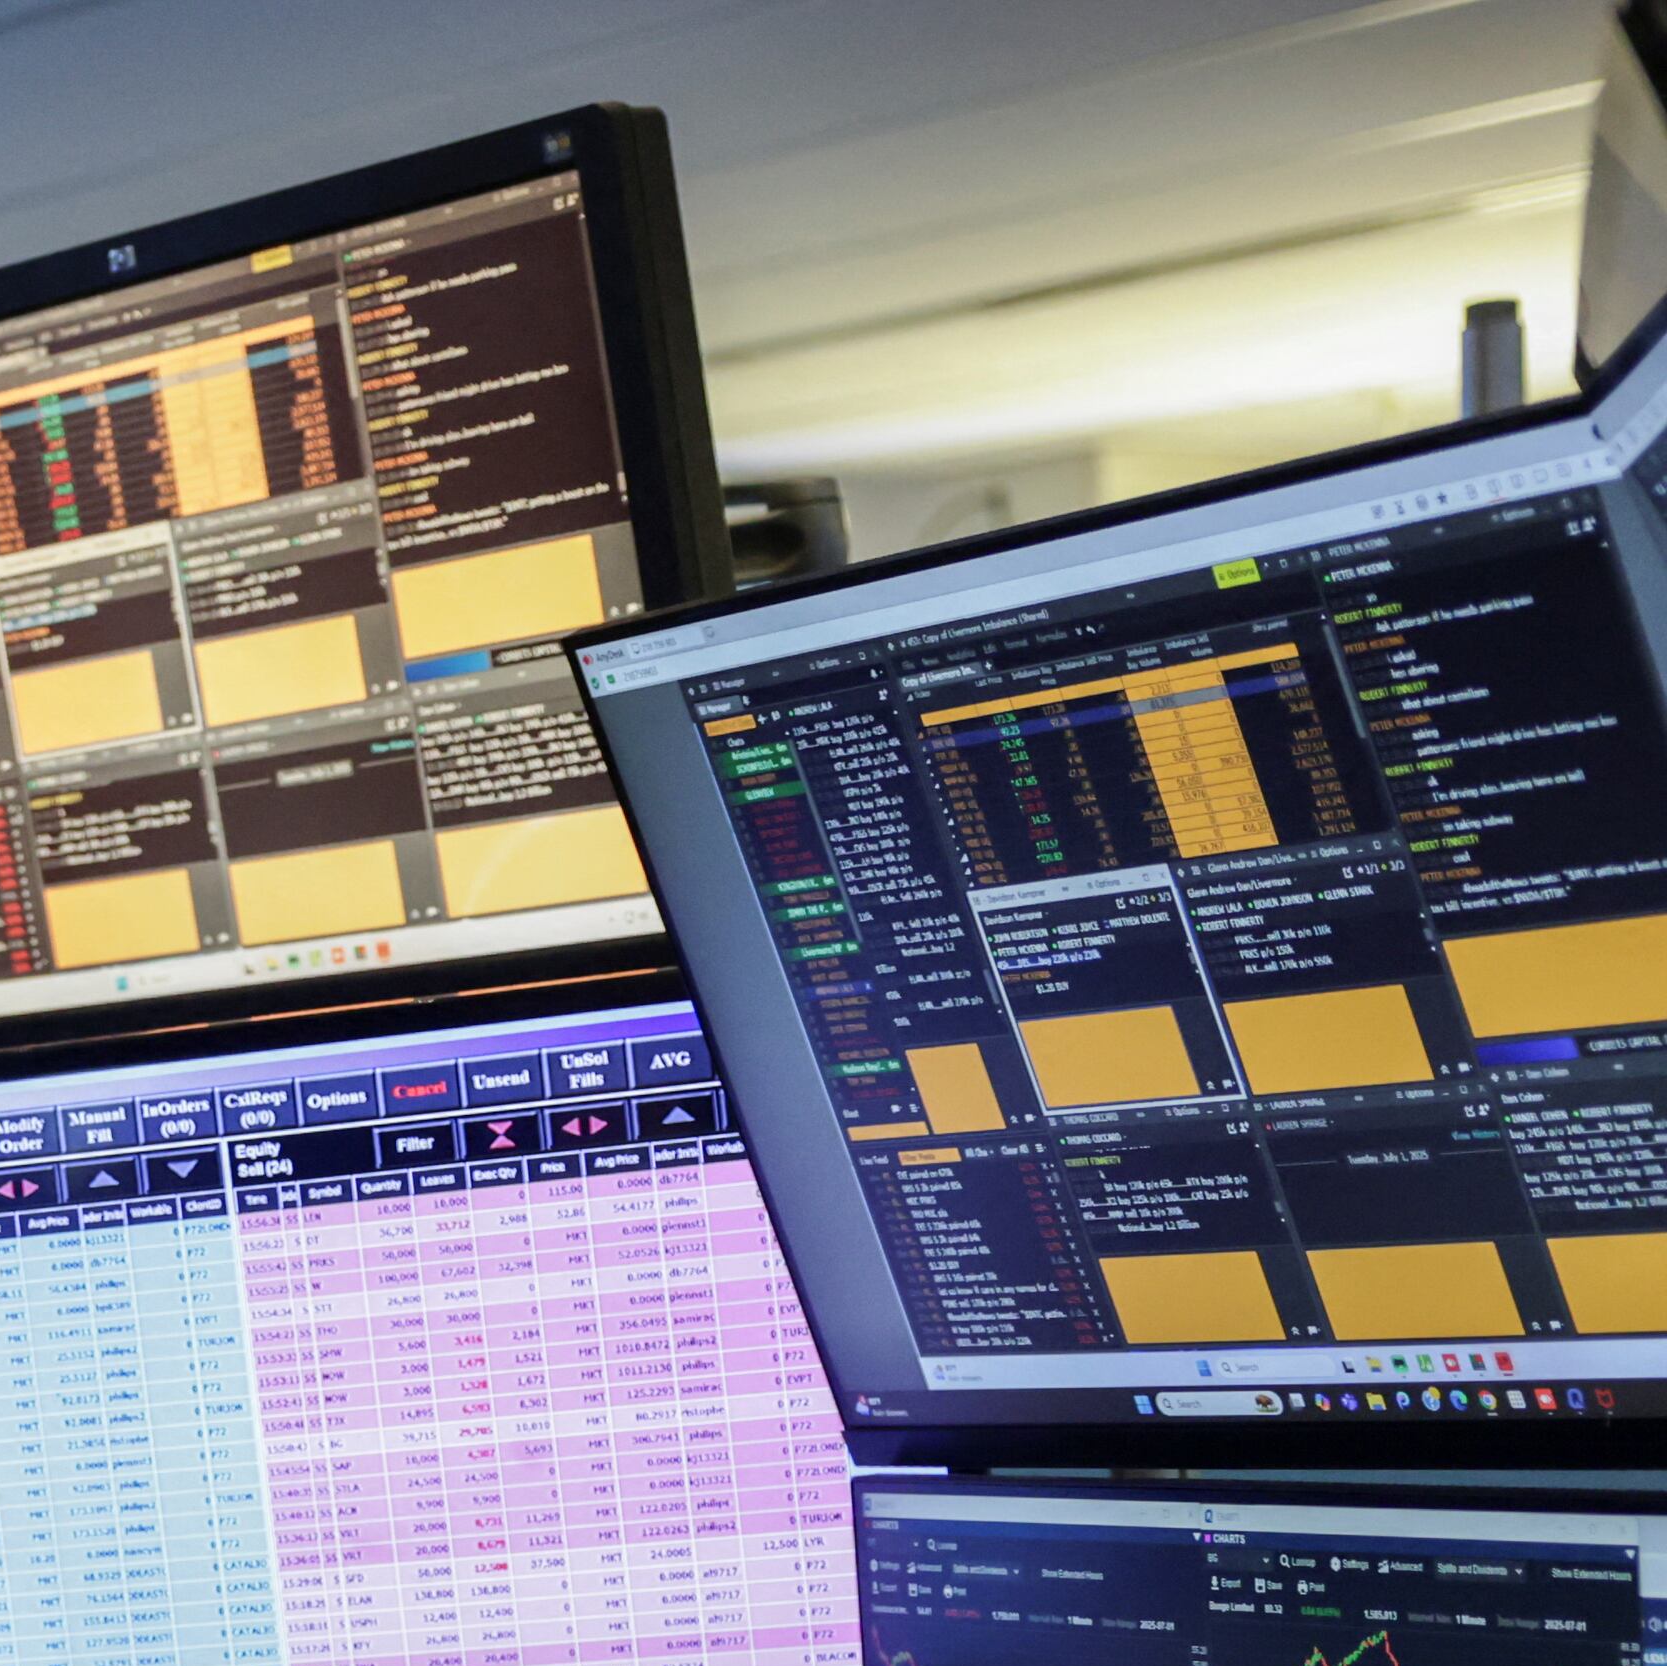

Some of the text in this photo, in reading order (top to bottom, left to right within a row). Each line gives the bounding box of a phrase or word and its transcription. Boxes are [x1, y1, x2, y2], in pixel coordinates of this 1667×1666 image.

[560, 1050, 609, 1069] UnSol
[649, 1052, 691, 1070] AVG
[473, 1070, 530, 1090] Unsend
[569, 1073, 605, 1090] Fills
[392, 1081, 448, 1099] Cancel
[142, 1098, 210, 1119] InOrders
[223, 1090, 288, 1109] CxlReqs
[306, 1091, 367, 1111] Options
[68, 1106, 126, 1127] Manual
[86, 1128, 114, 1145] Fill
[396, 1136, 435, 1153] Filter
[234, 1141, 281, 1160] Equity
[237, 1159, 294, 1179] Sell (24)
[540, 1161, 565, 1174] Price
[594, 1153, 640, 1169] Avg Price
[360, 1179, 402, 1194] Quantity
[420, 1174, 456, 1188] Leaves
[1213, 1533, 1246, 1545] CHARTS
